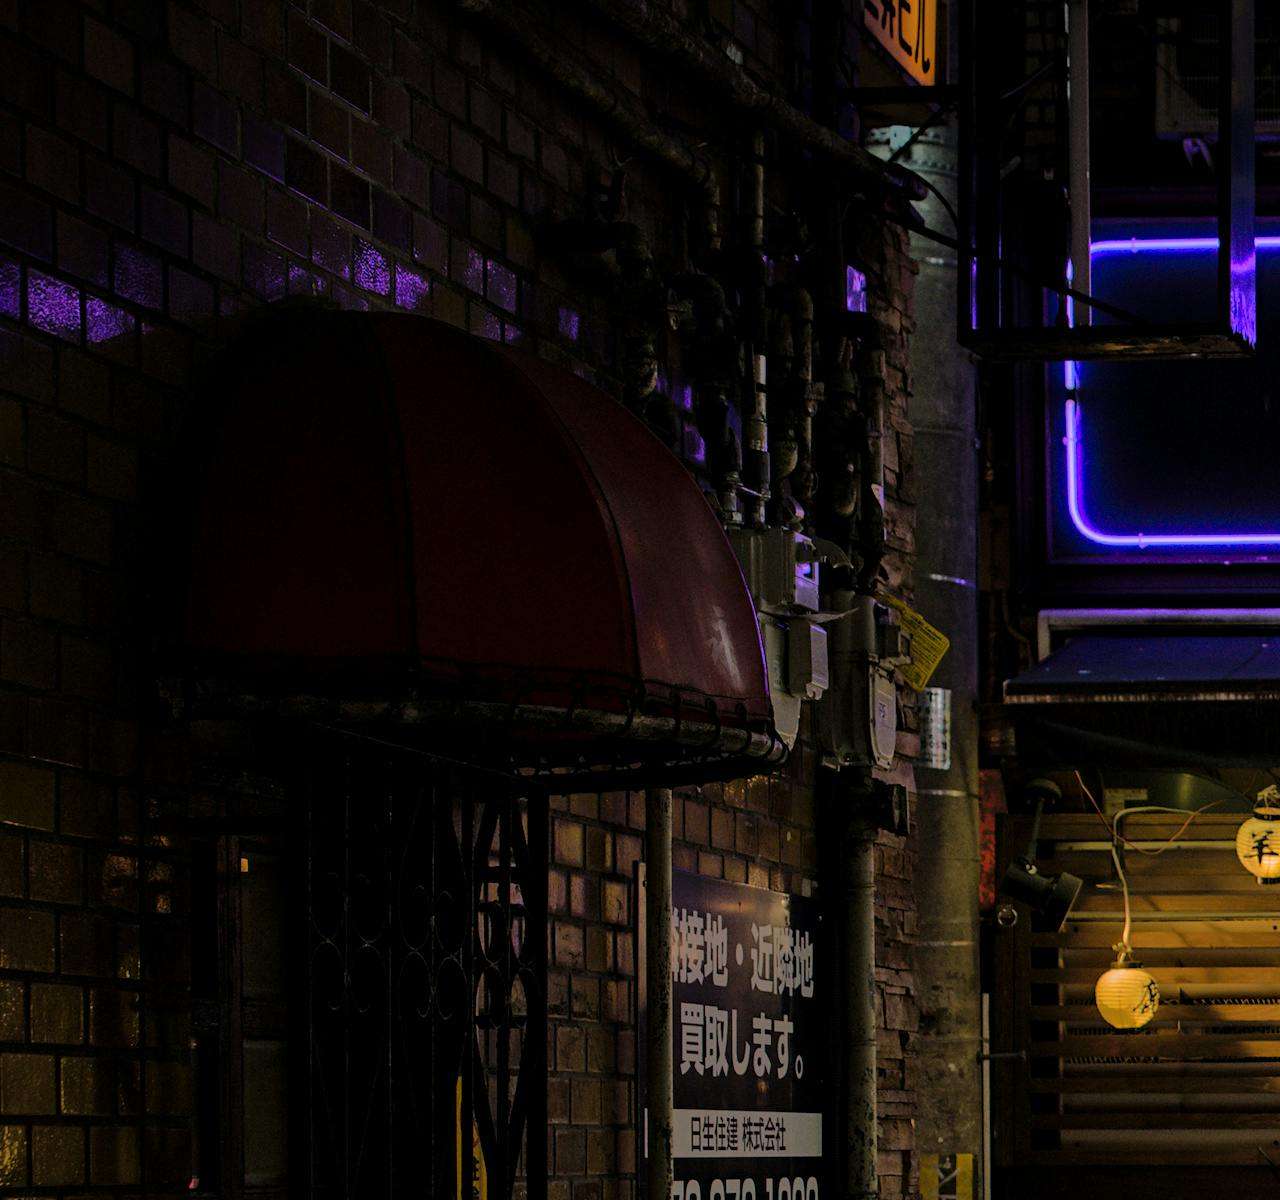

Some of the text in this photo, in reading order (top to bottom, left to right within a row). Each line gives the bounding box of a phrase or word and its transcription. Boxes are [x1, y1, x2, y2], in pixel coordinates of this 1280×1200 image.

[672, 905, 815, 999] 接地・近隣地
[680, 1002, 804, 1080] 買取します。
[691, 1116, 787, 1152] 日生住建 株式会社
